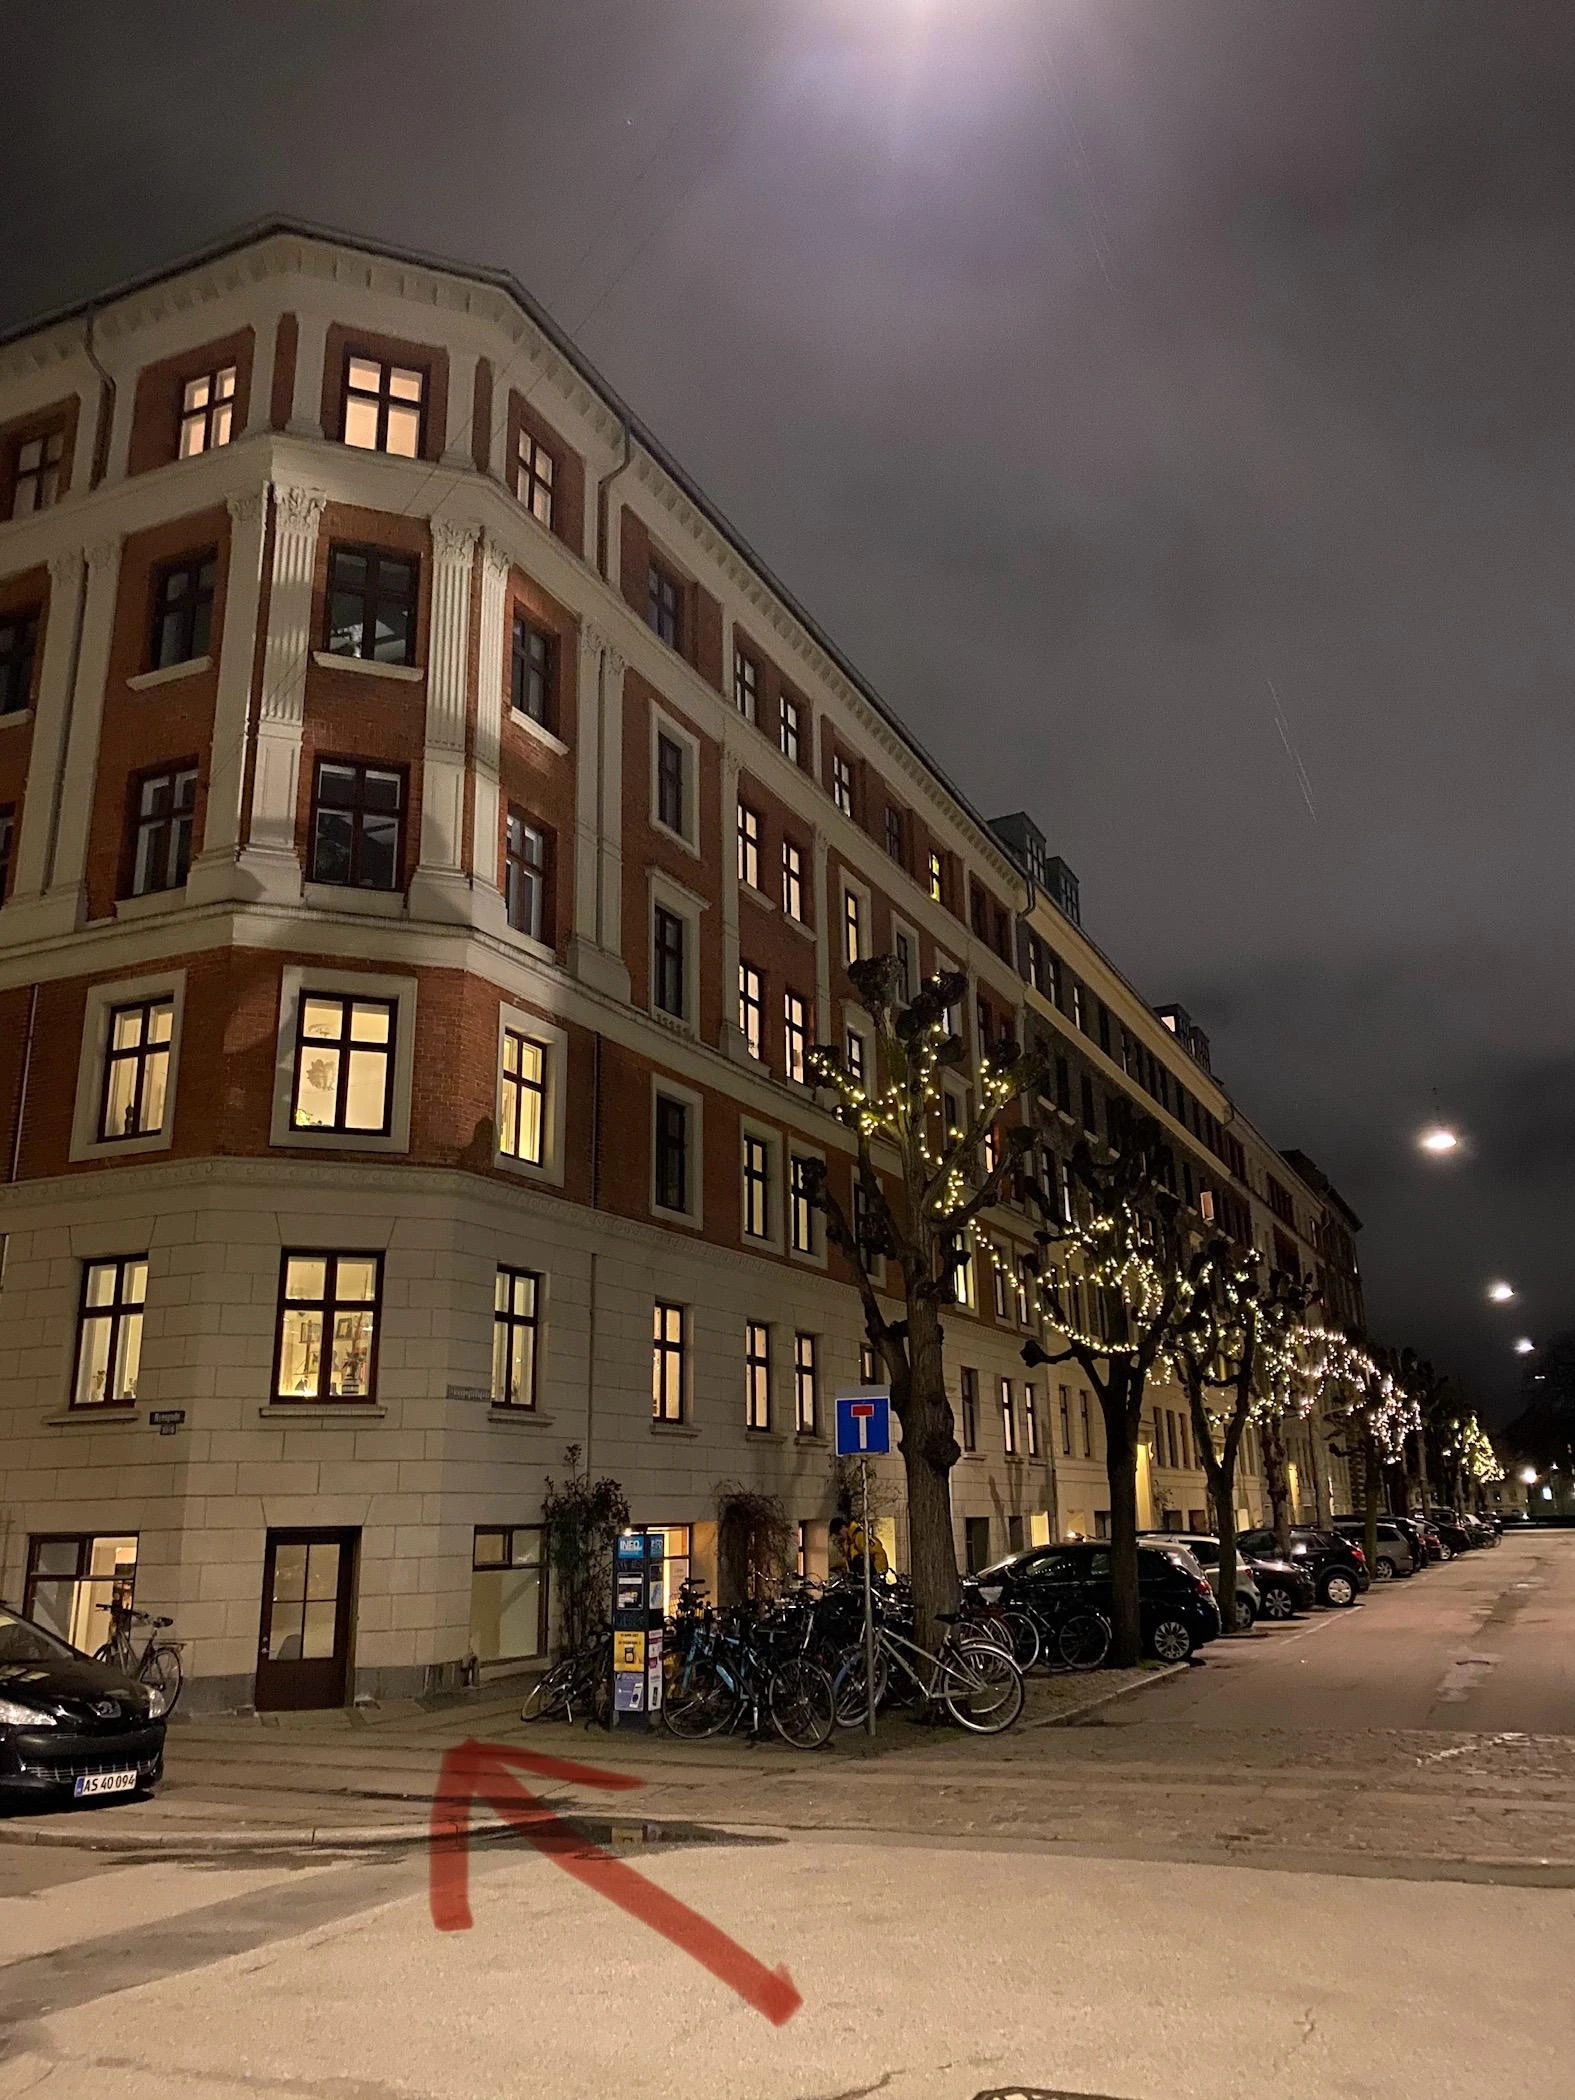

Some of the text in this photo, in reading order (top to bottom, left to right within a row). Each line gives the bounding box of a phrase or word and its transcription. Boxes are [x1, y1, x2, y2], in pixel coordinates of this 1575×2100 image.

[84, 1774, 135, 1792] AS 40 094
